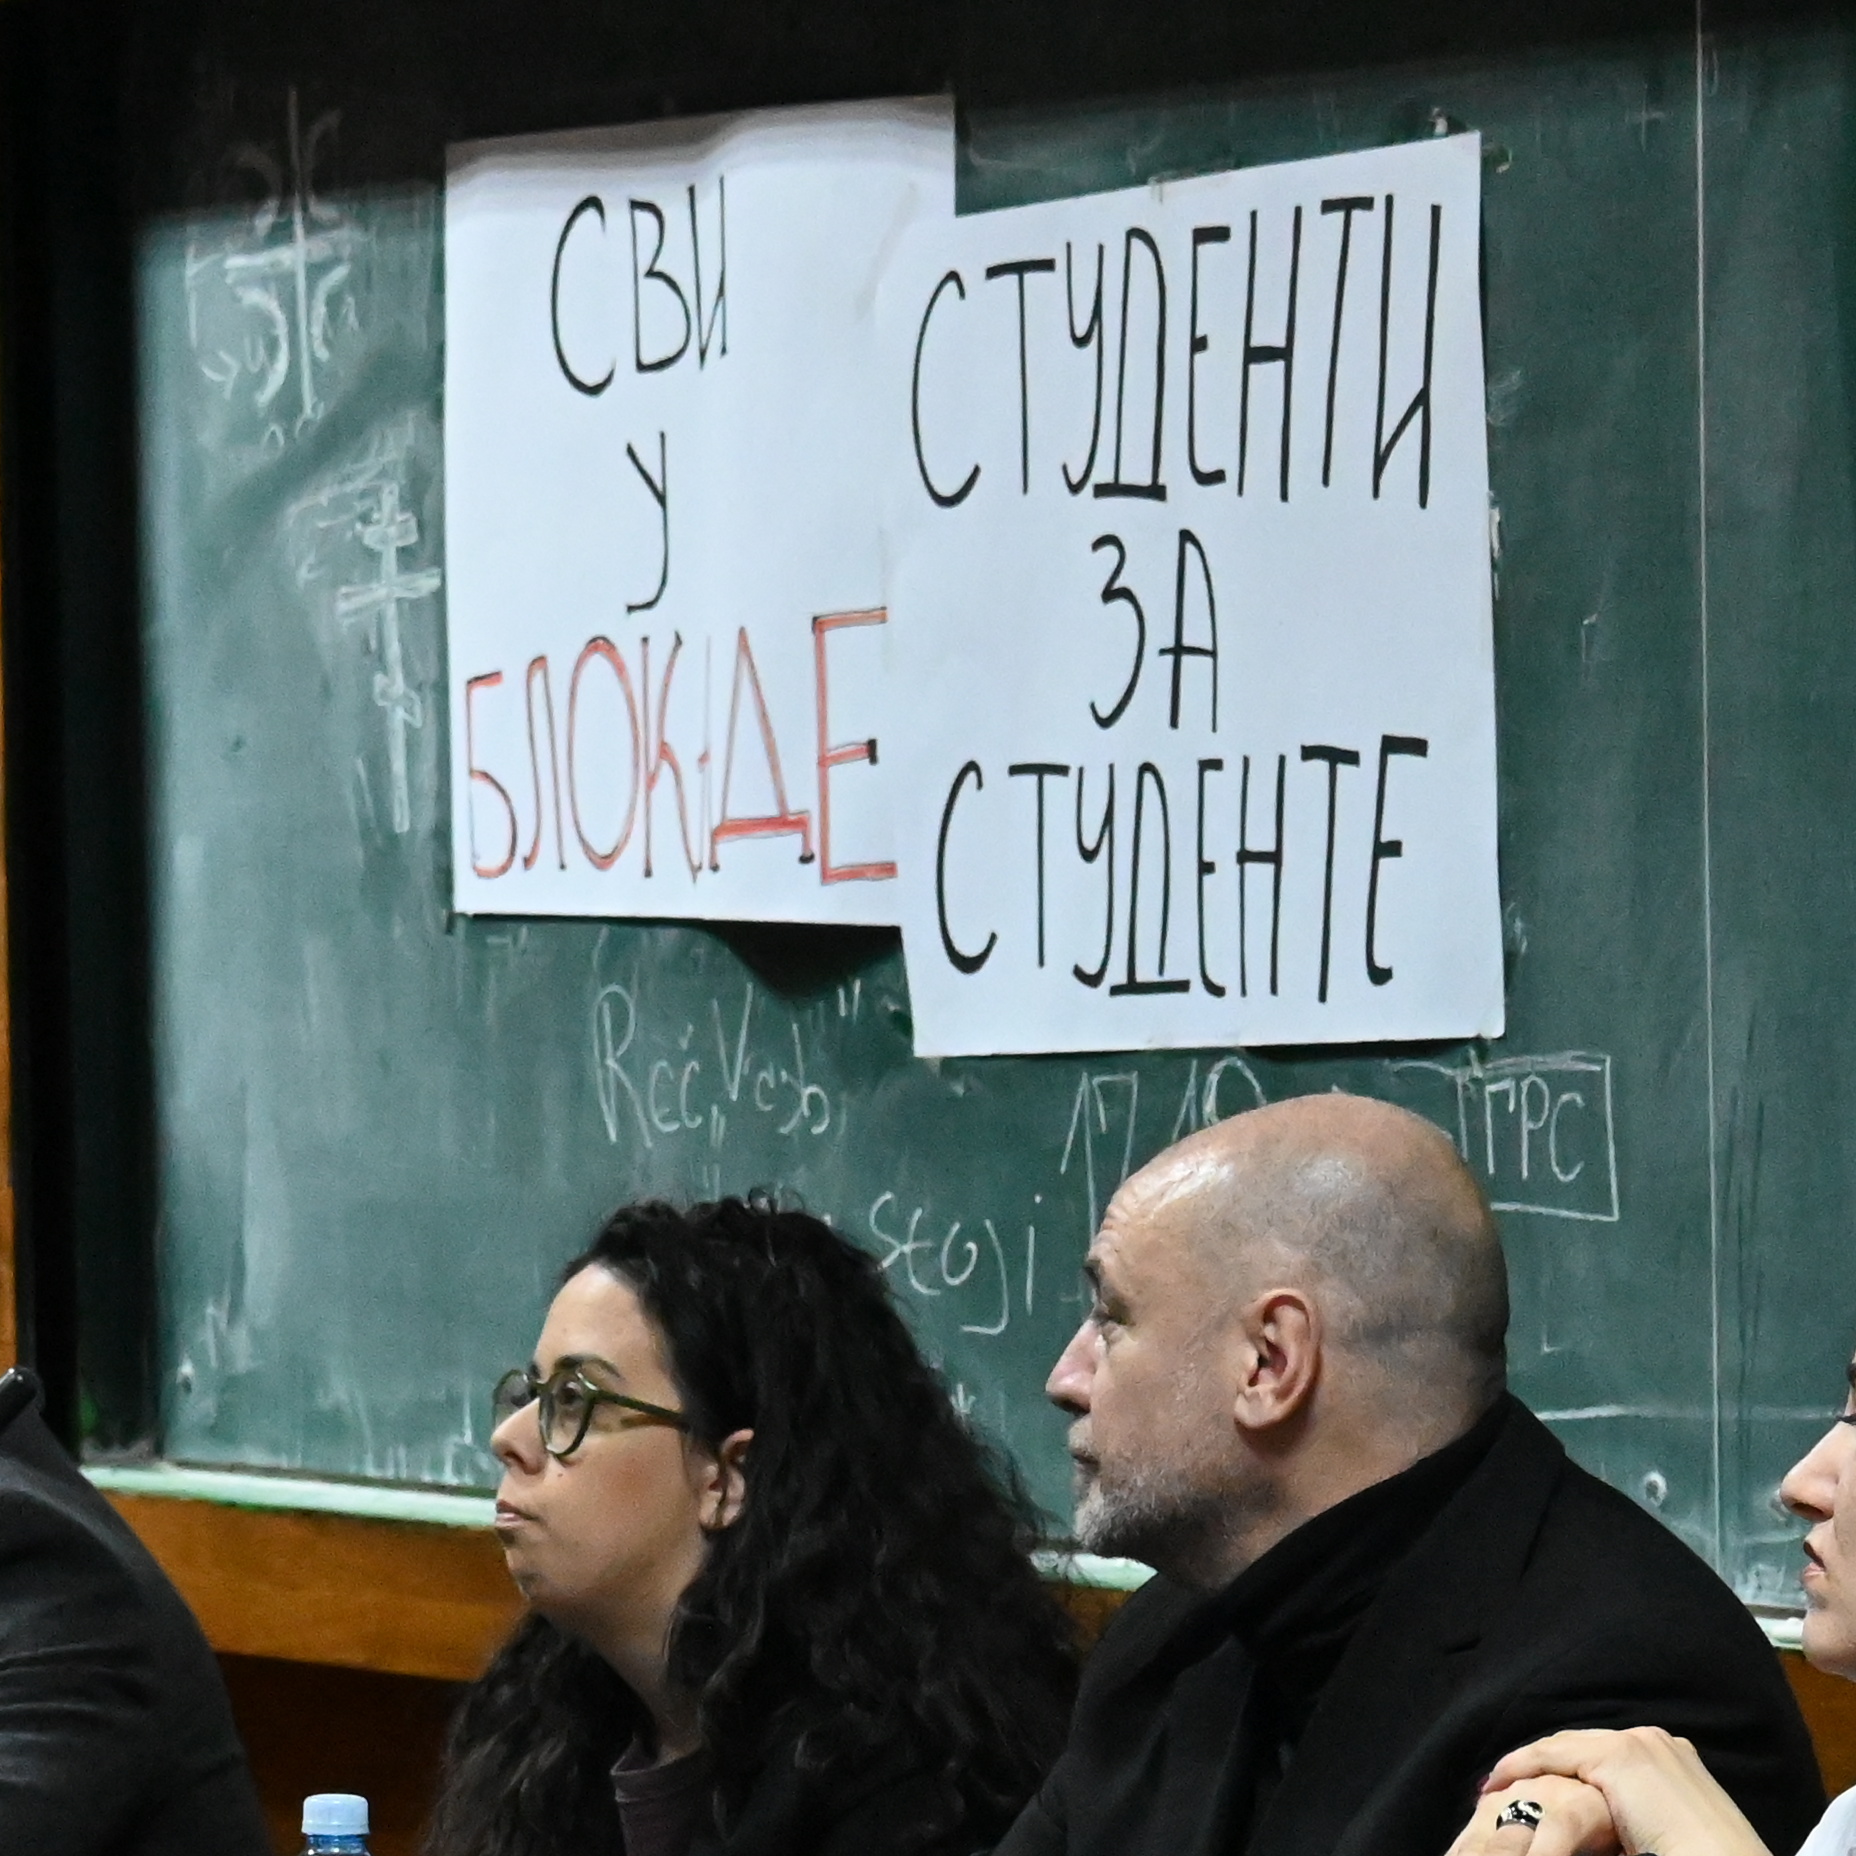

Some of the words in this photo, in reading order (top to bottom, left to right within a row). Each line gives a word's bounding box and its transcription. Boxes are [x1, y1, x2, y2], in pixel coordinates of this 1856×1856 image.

[551, 174, 730, 397] СВИ
[910, 192, 1443, 511] СТУДЕНТИ
[625, 430, 669, 614] У
[1088, 527, 1221, 734] ЗА
[935, 733, 1430, 1005] СТУДЕНТЕ
